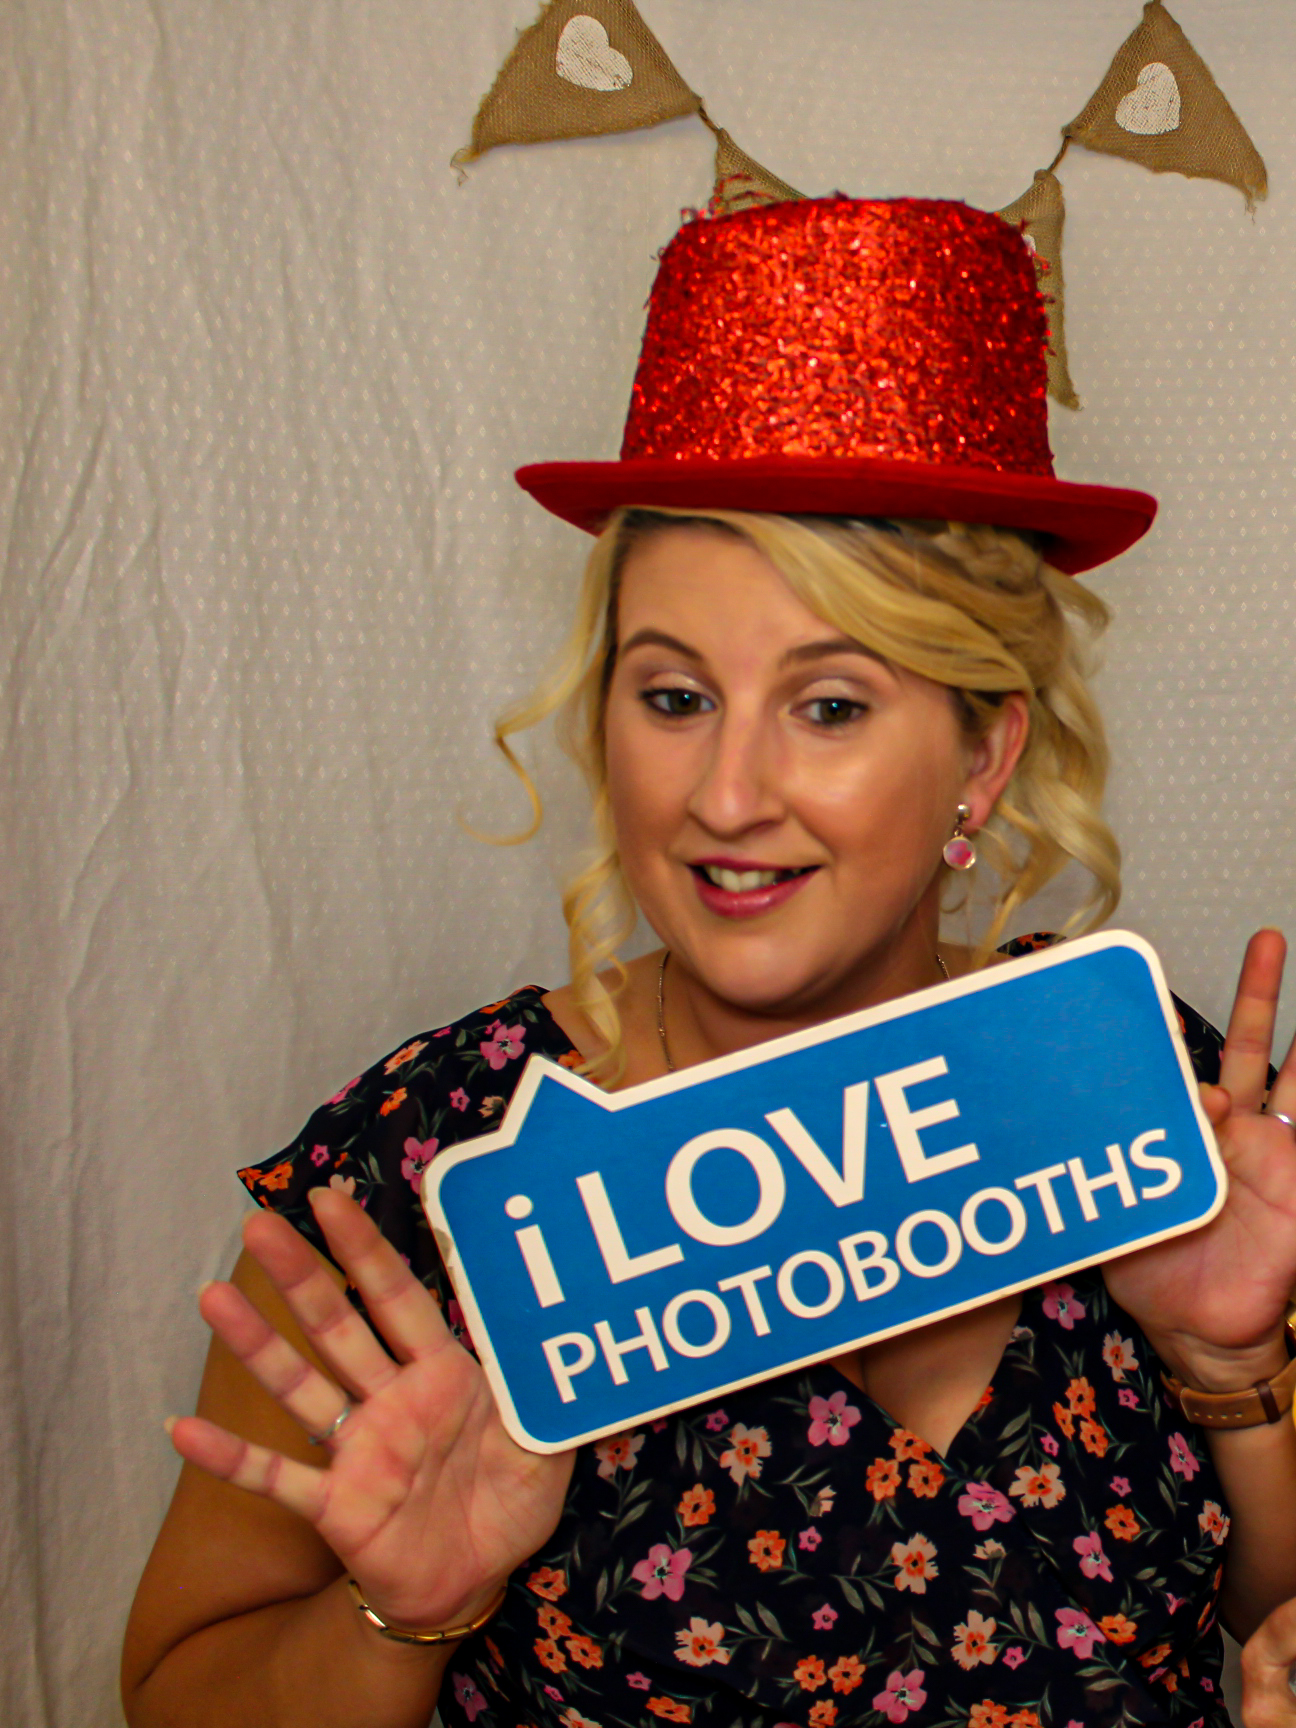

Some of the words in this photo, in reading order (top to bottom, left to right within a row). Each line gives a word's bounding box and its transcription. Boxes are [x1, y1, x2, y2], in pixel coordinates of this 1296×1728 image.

[505, 1194, 566, 1308] i
[576, 1056, 980, 1285] LOVE
[540, 1128, 1183, 1403] PHOTOBOOTHS
